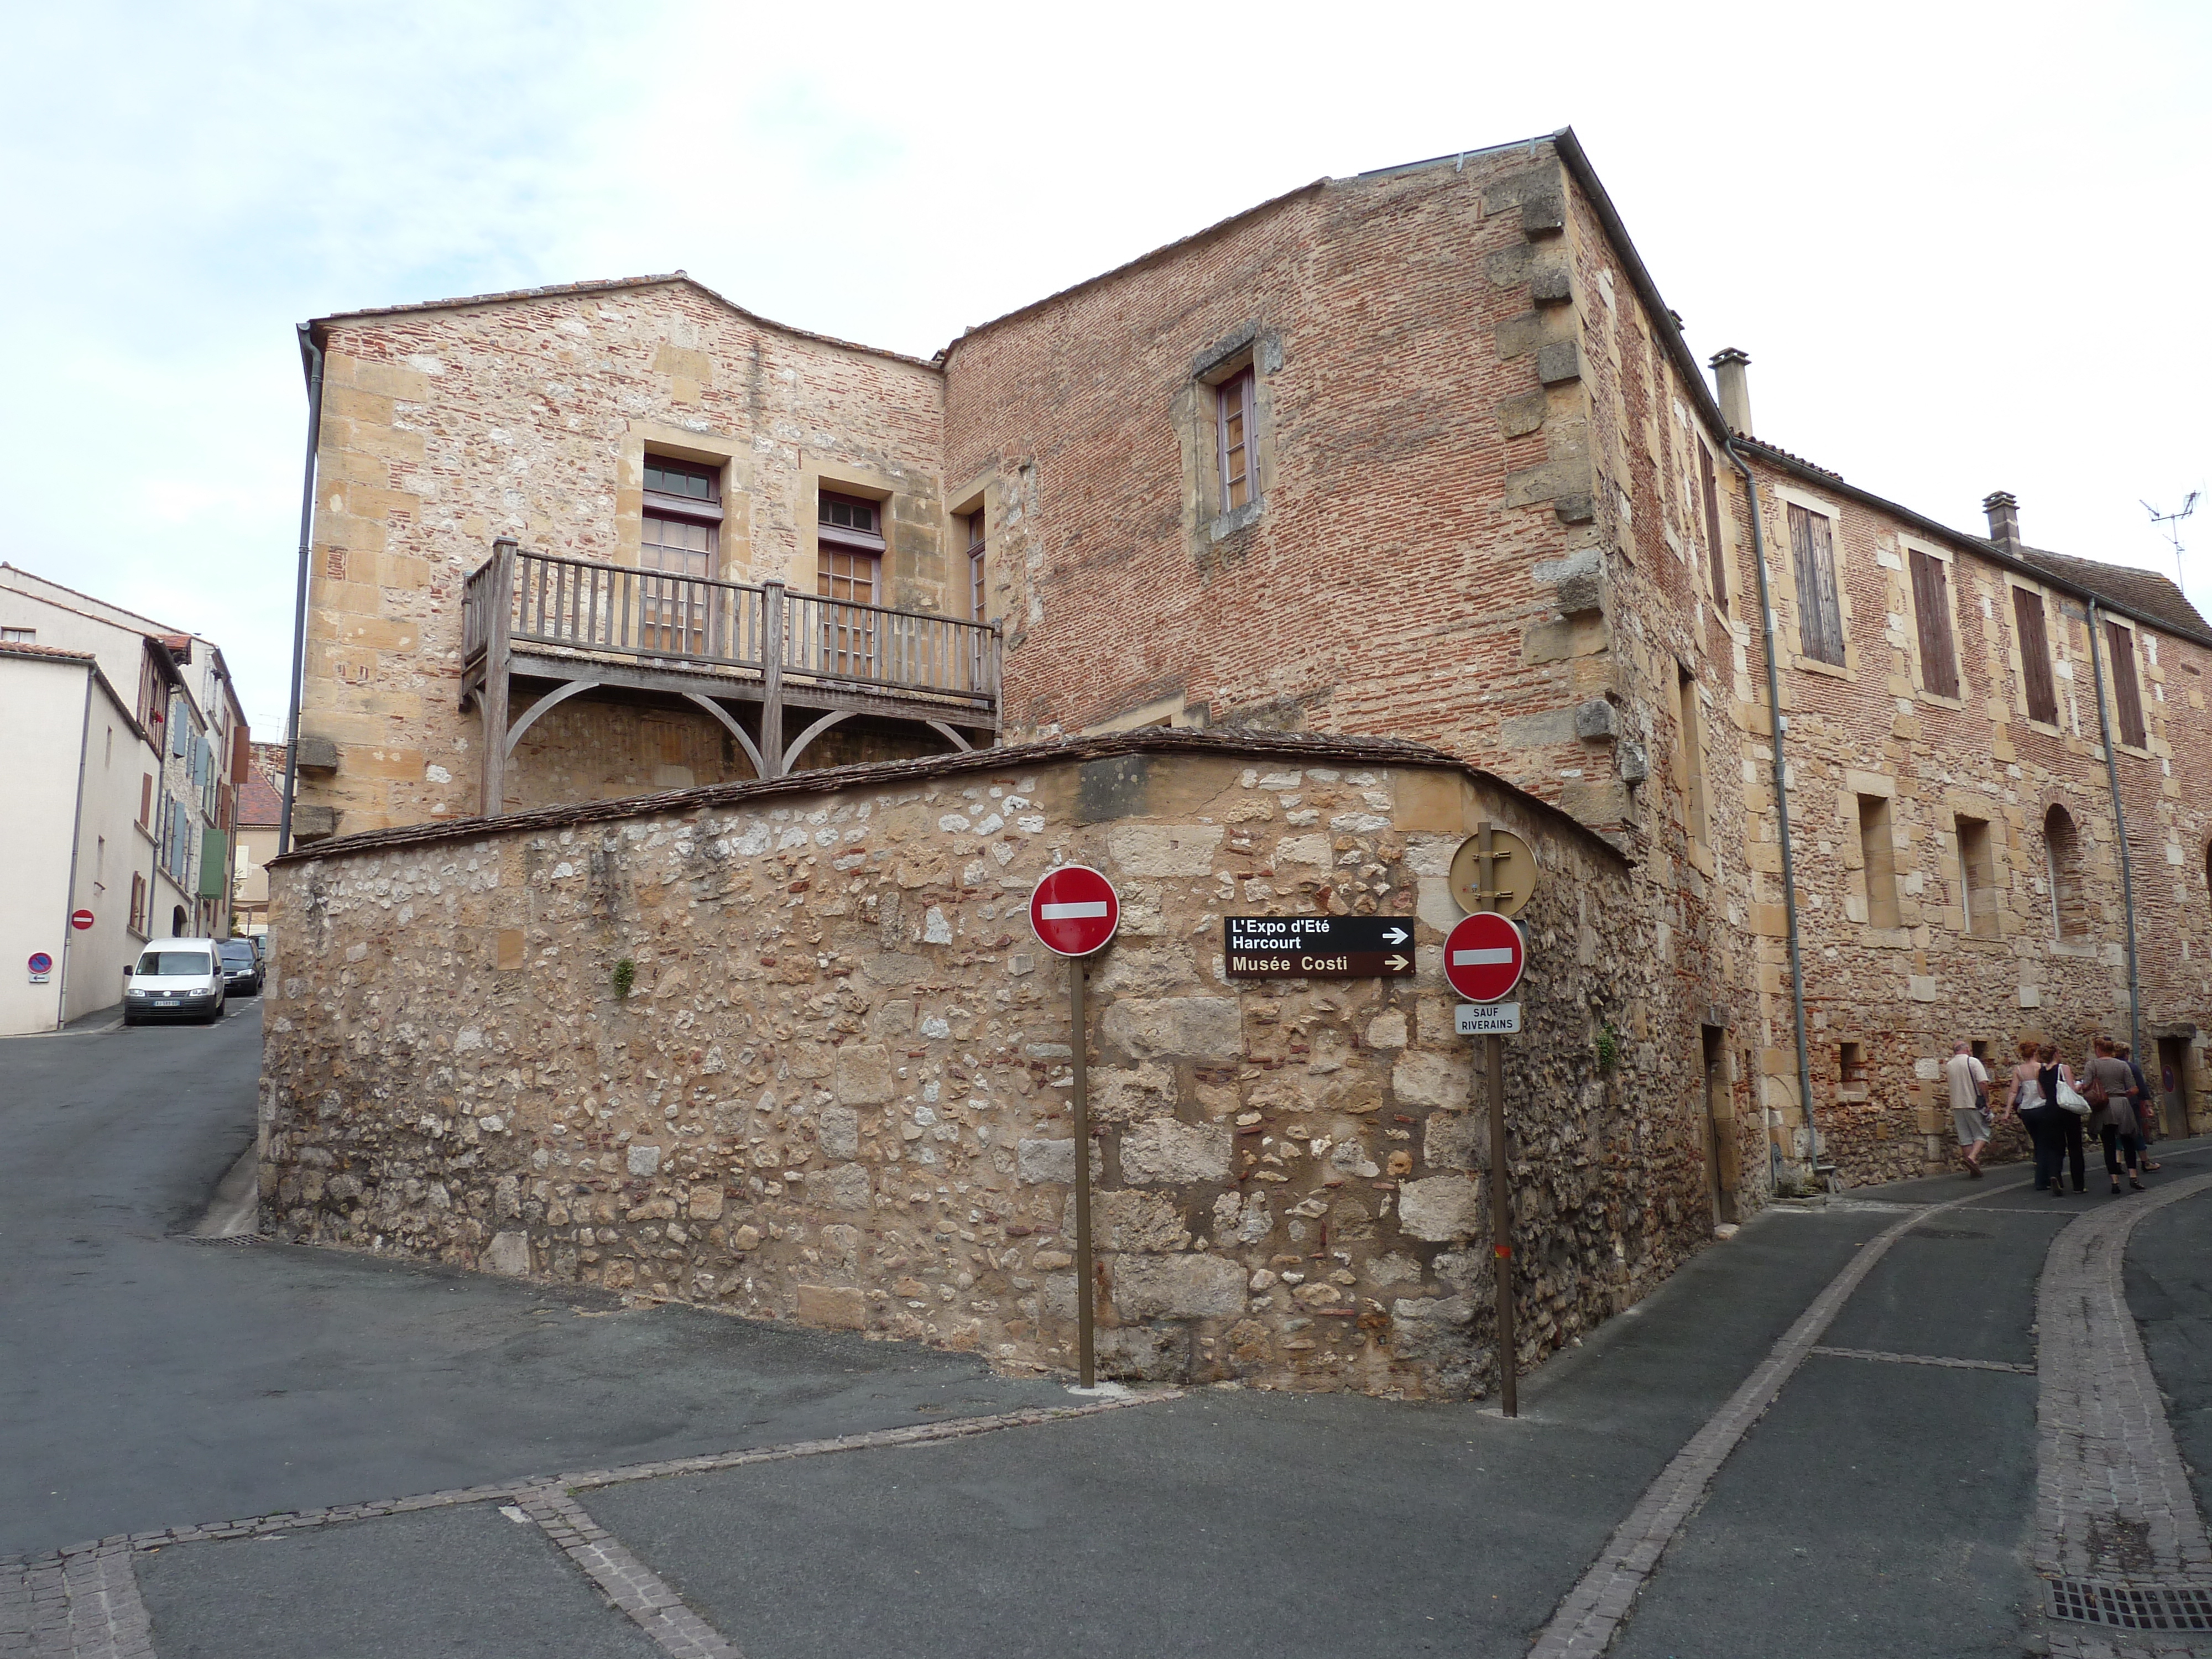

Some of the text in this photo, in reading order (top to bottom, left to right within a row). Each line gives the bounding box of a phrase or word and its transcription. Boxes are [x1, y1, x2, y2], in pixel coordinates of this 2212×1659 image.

[1232, 919, 1330, 936] L'Expo d'Eté
[1233, 936, 1301, 949] Harcourt
[1233, 956, 1348, 971] Musée Costi
[1473, 1008, 1499, 1017] SAUF
[1462, 1019, 1513, 1030] RIVERAINS
